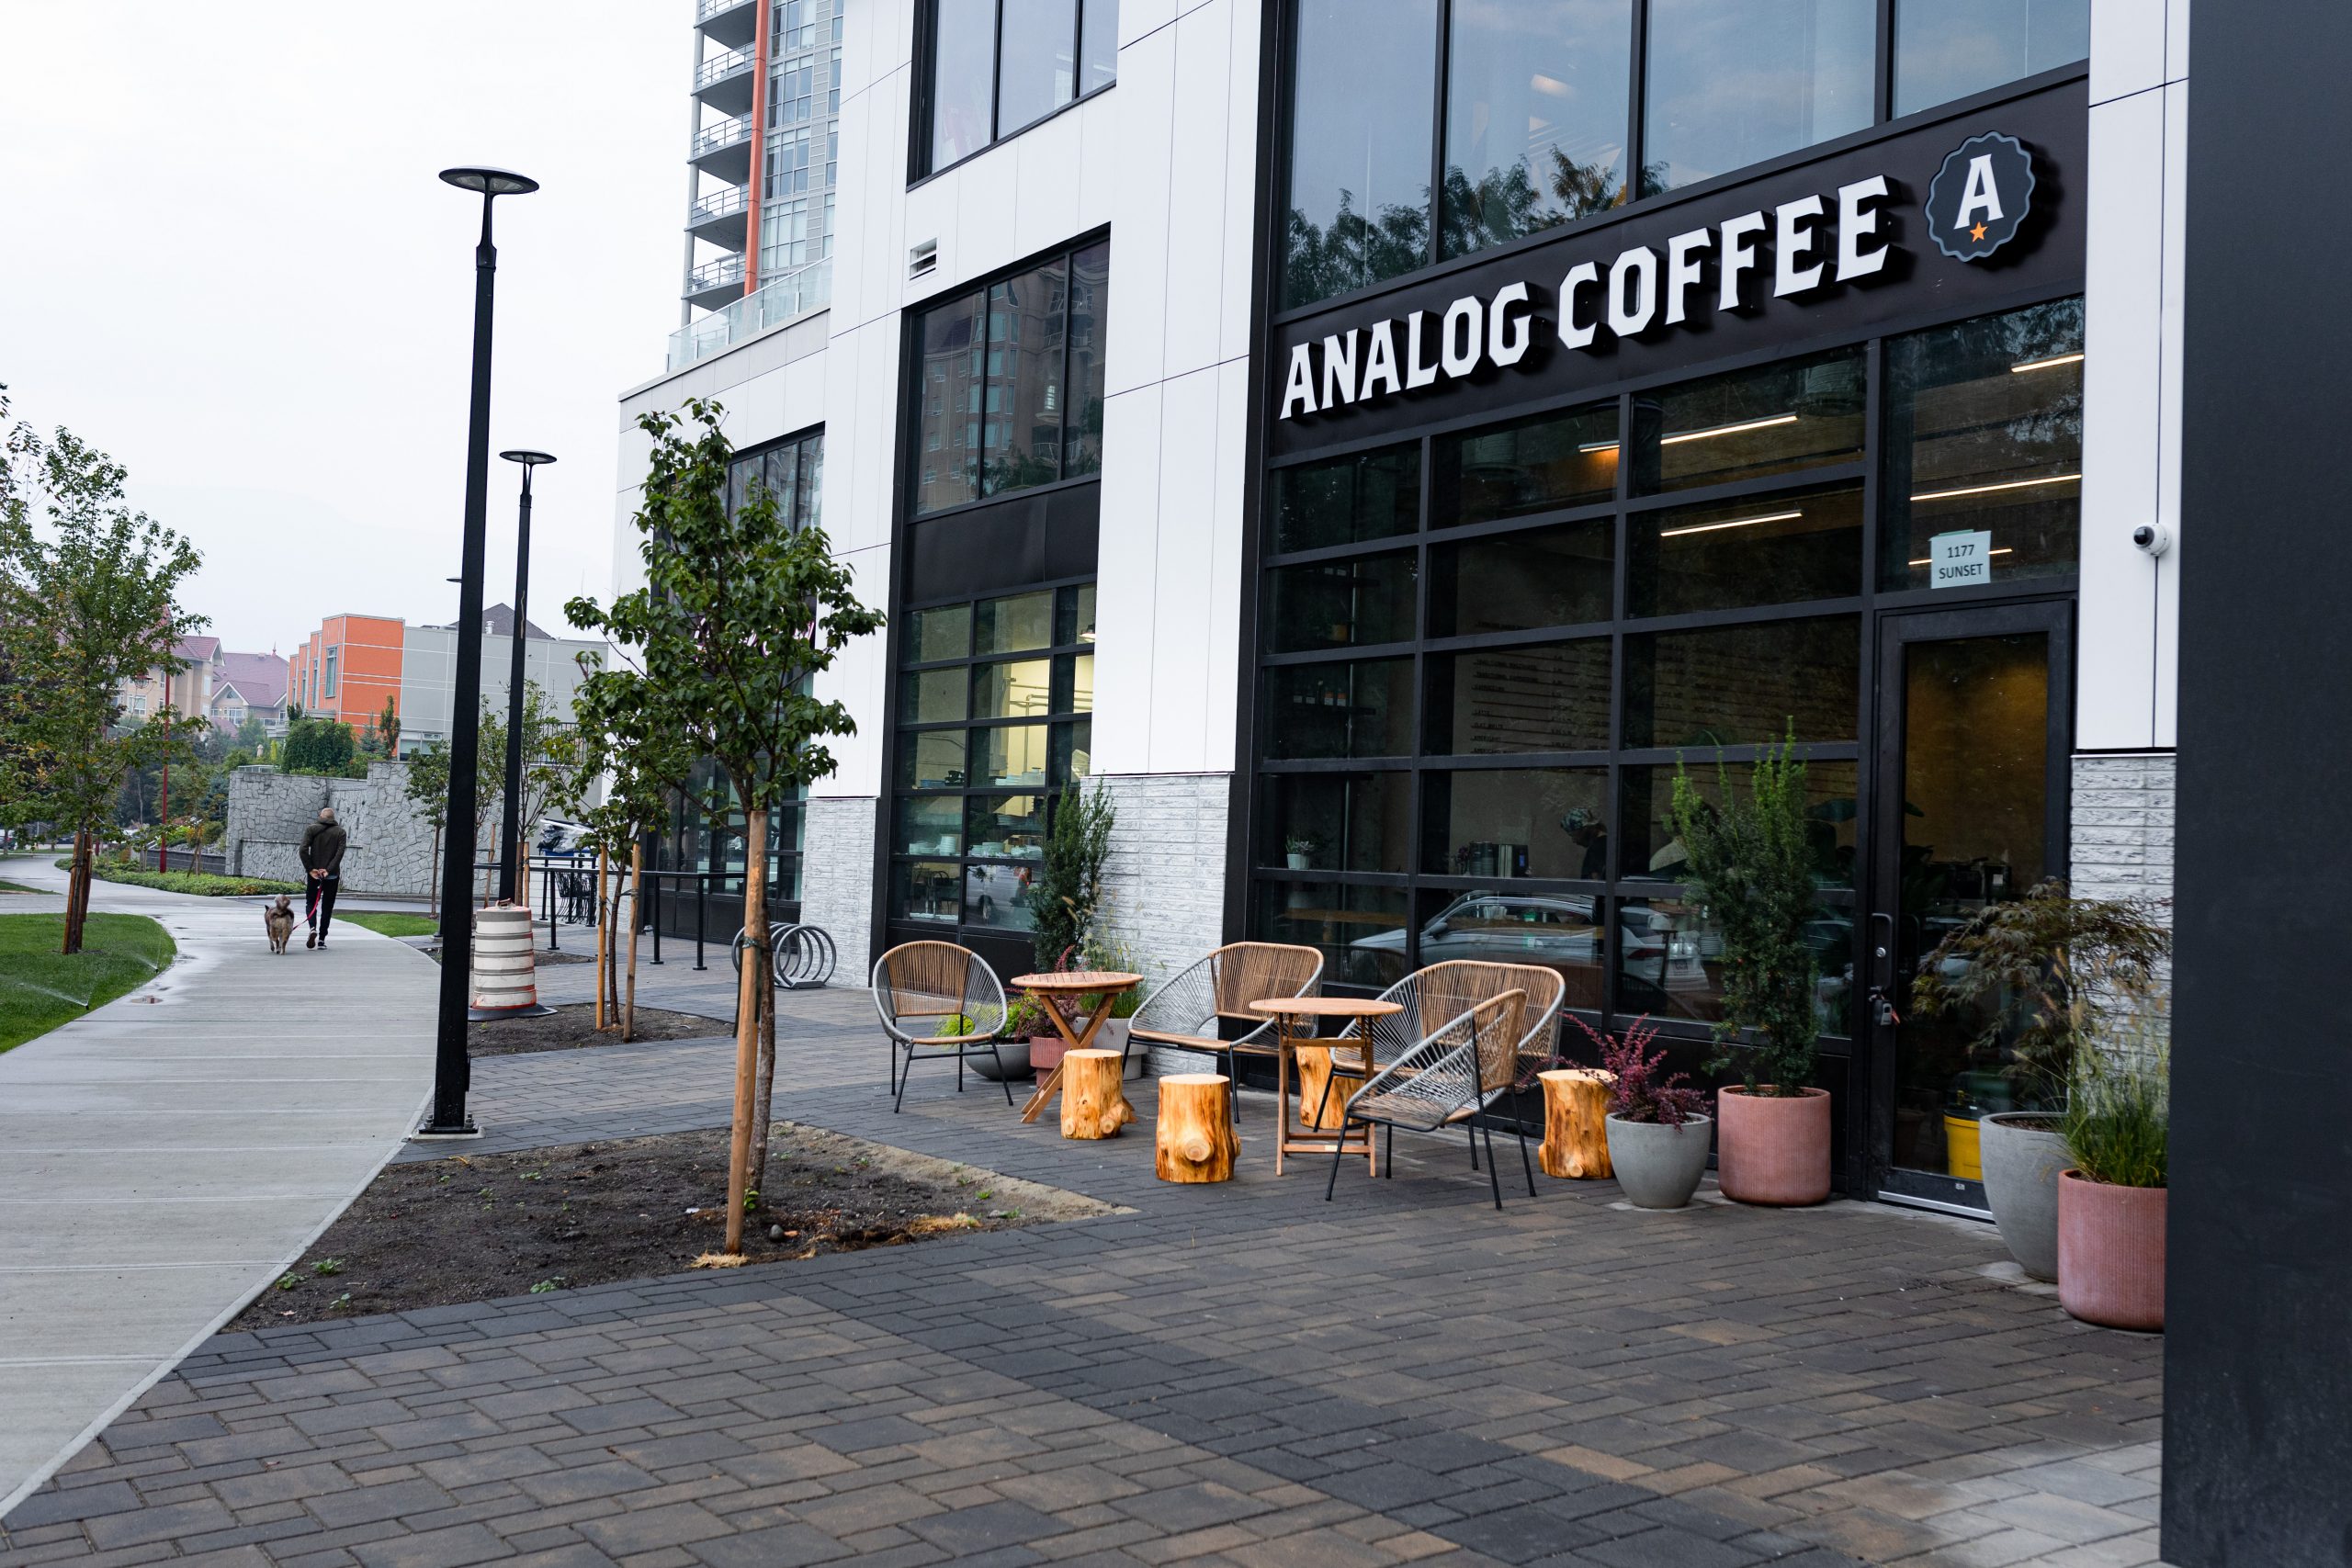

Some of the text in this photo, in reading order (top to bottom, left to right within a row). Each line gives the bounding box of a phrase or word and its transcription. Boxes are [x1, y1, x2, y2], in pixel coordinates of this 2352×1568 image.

[1953, 153, 2004, 230] A
[1279, 175, 1889, 420] ANALOG COFFEE
[1939, 563, 1984, 580] SUNSET
[1947, 544, 1974, 558] 1177
